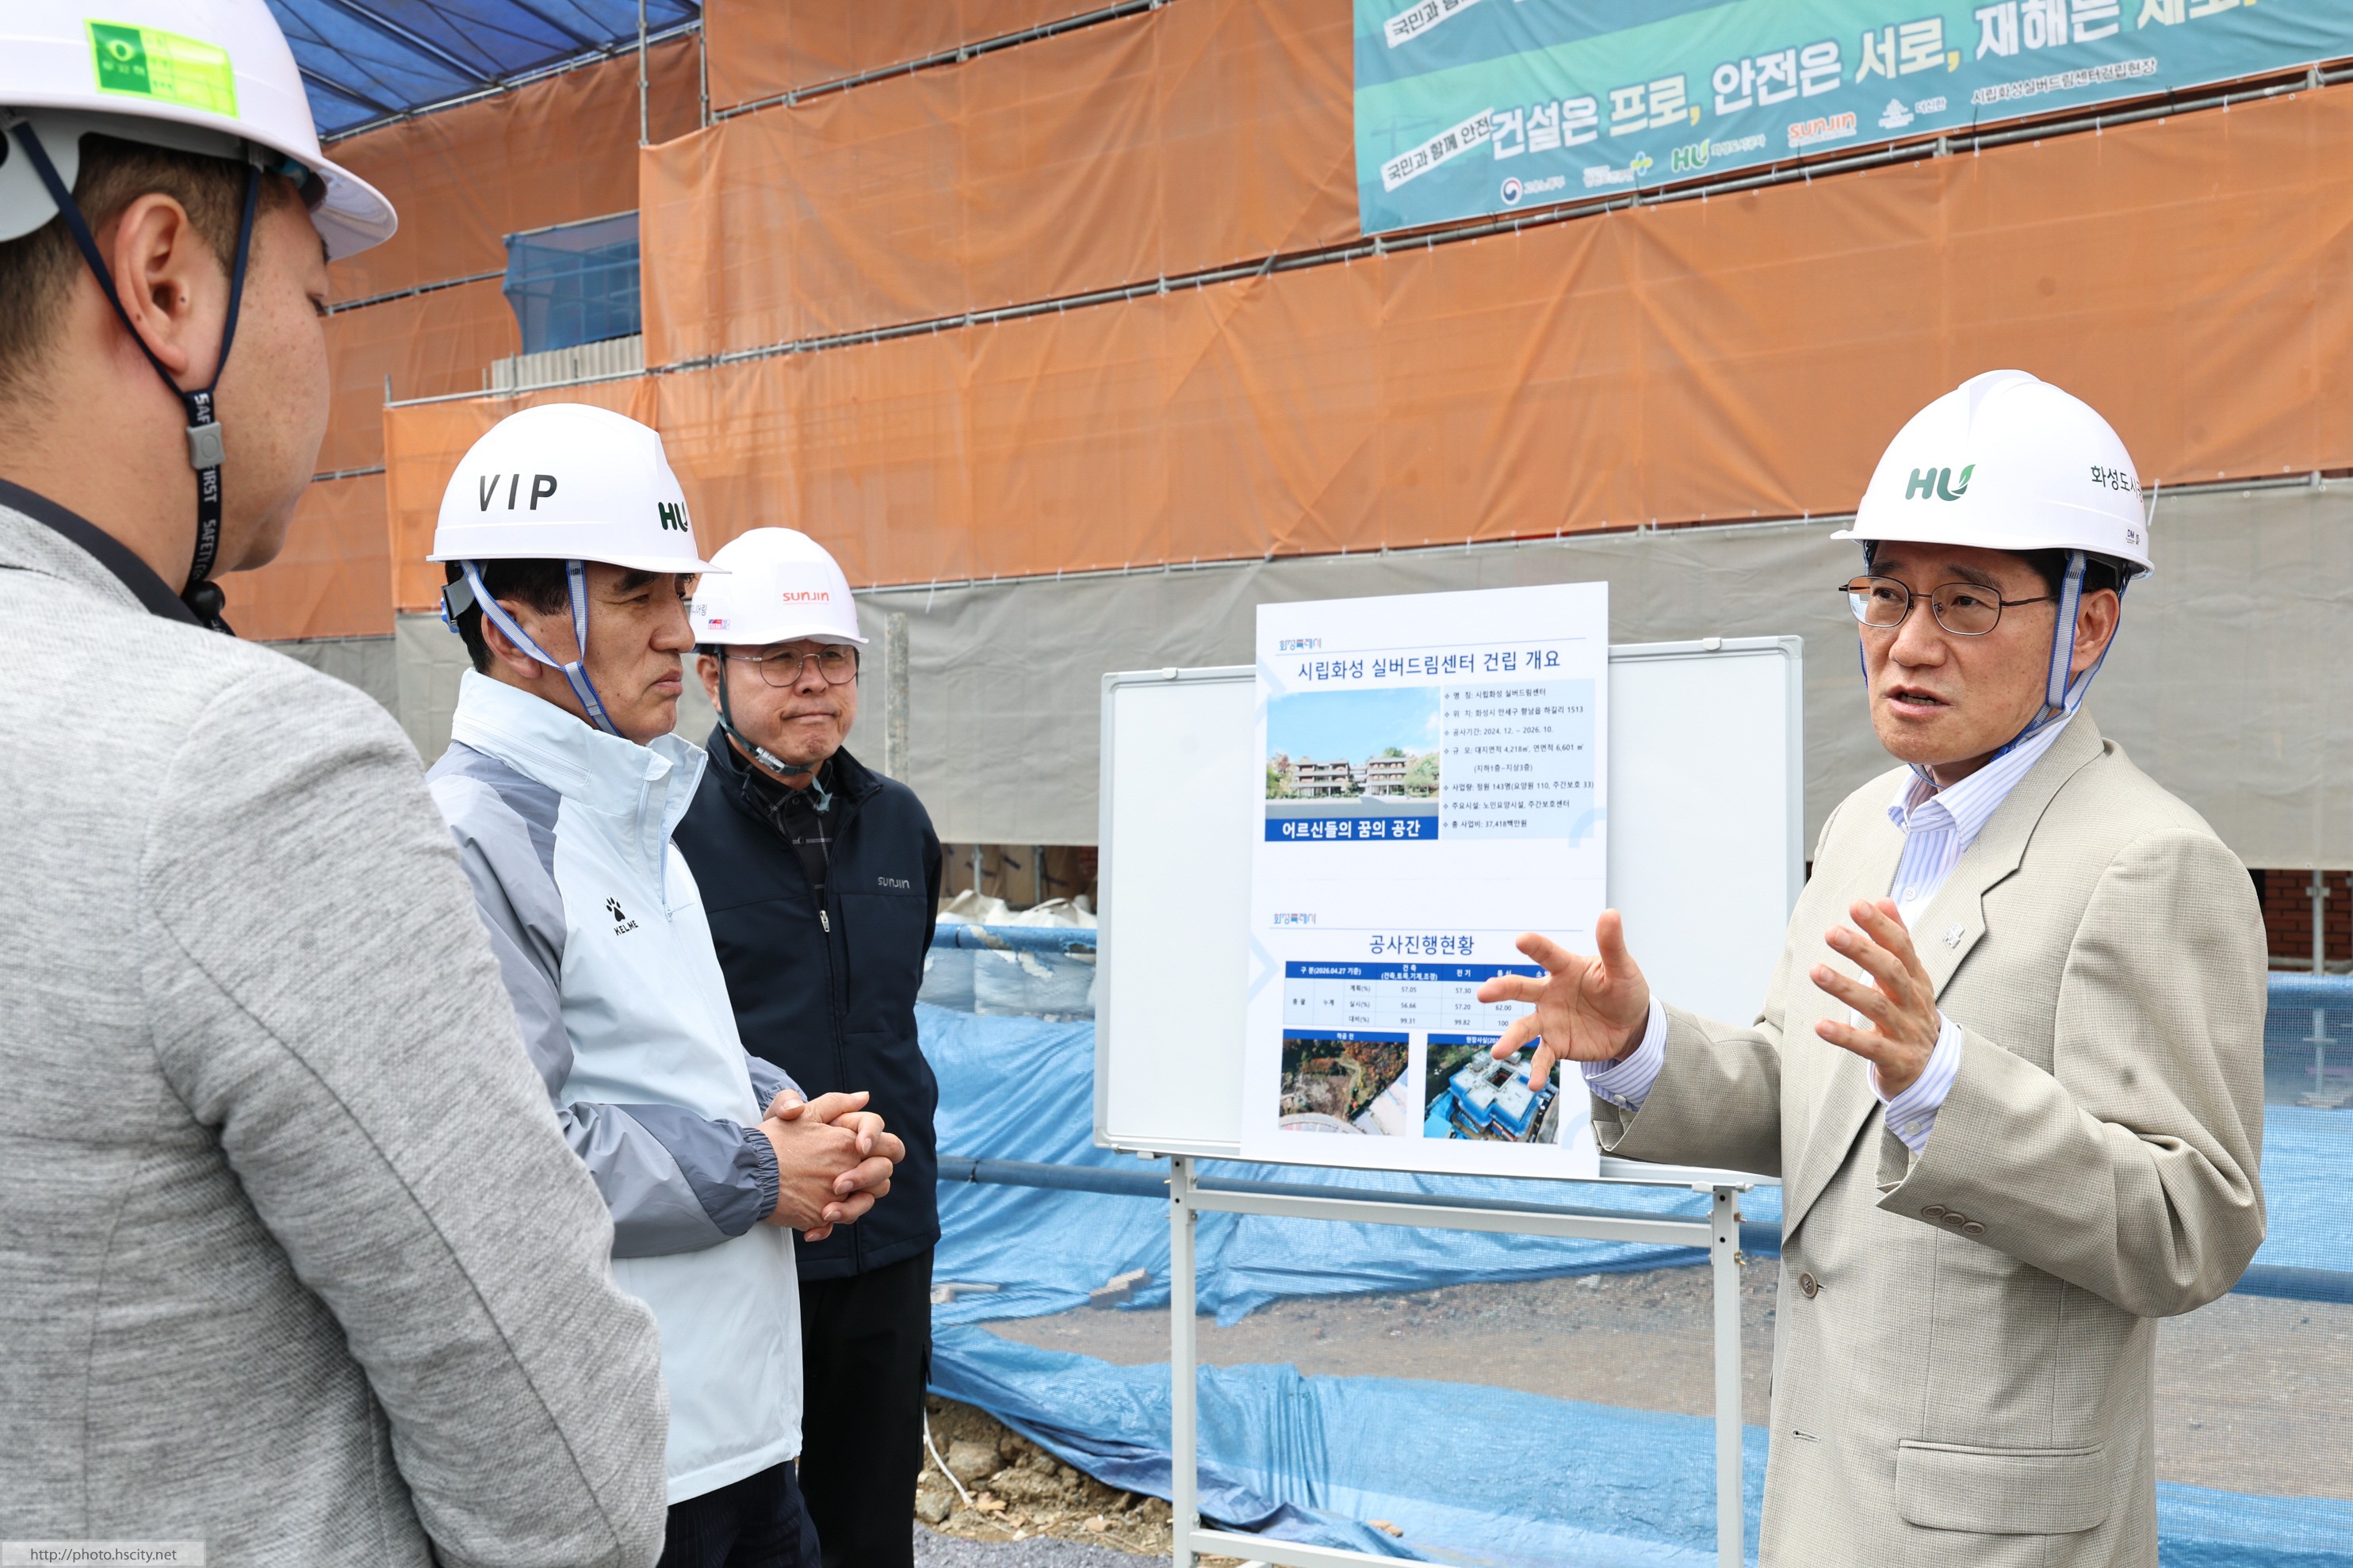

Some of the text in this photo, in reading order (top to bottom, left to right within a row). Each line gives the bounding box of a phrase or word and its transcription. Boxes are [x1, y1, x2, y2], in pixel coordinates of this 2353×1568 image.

[1490, 96, 1598, 161] 건설은
[1609, 75, 1701, 136] 프로,
[1712, 40, 1842, 116] 안전은
[1854, 17, 1961, 82] 서로,
[1974, 0, 2121, 61] 재해는
[1387, 117, 1491, 181] 국민과 함께 안전
[1905, 464, 1976, 502] HU
[479, 473, 558, 511] VIP
[197, 519, 216, 562] SAFETY
[1298, 649, 1561, 681] 시립화성 실버드림센터 건립 개요
[1475, 690, 1503, 699] 시립화성
[1505, 687, 1547, 698] 실버드림센터
[1453, 709, 1460, 718] 위
[1475, 708, 1496, 717] 화성시
[1544, 705, 1565, 714] 하길리
[1453, 728, 1482, 736] 공사기간:
[1475, 745, 1502, 754] 대지면적
[1533, 744, 1554, 752] 연면적
[1452, 783, 1475, 792] 사업량:
[1493, 782, 1534, 791] 143명(요양원
[1552, 781, 1581, 790] 주간보호
[1583, 780, 1594, 790] 33)
[1452, 799, 1570, 810] 주요시설: 노인요양시설, 주간보호센터
[1282, 820, 1421, 839] 어르신들의 꿈의 공간
[1461, 820, 1483, 828] 사업비:
[614, 920, 639, 936] KELME
[1368, 935, 1475, 956] 공사진행현황
